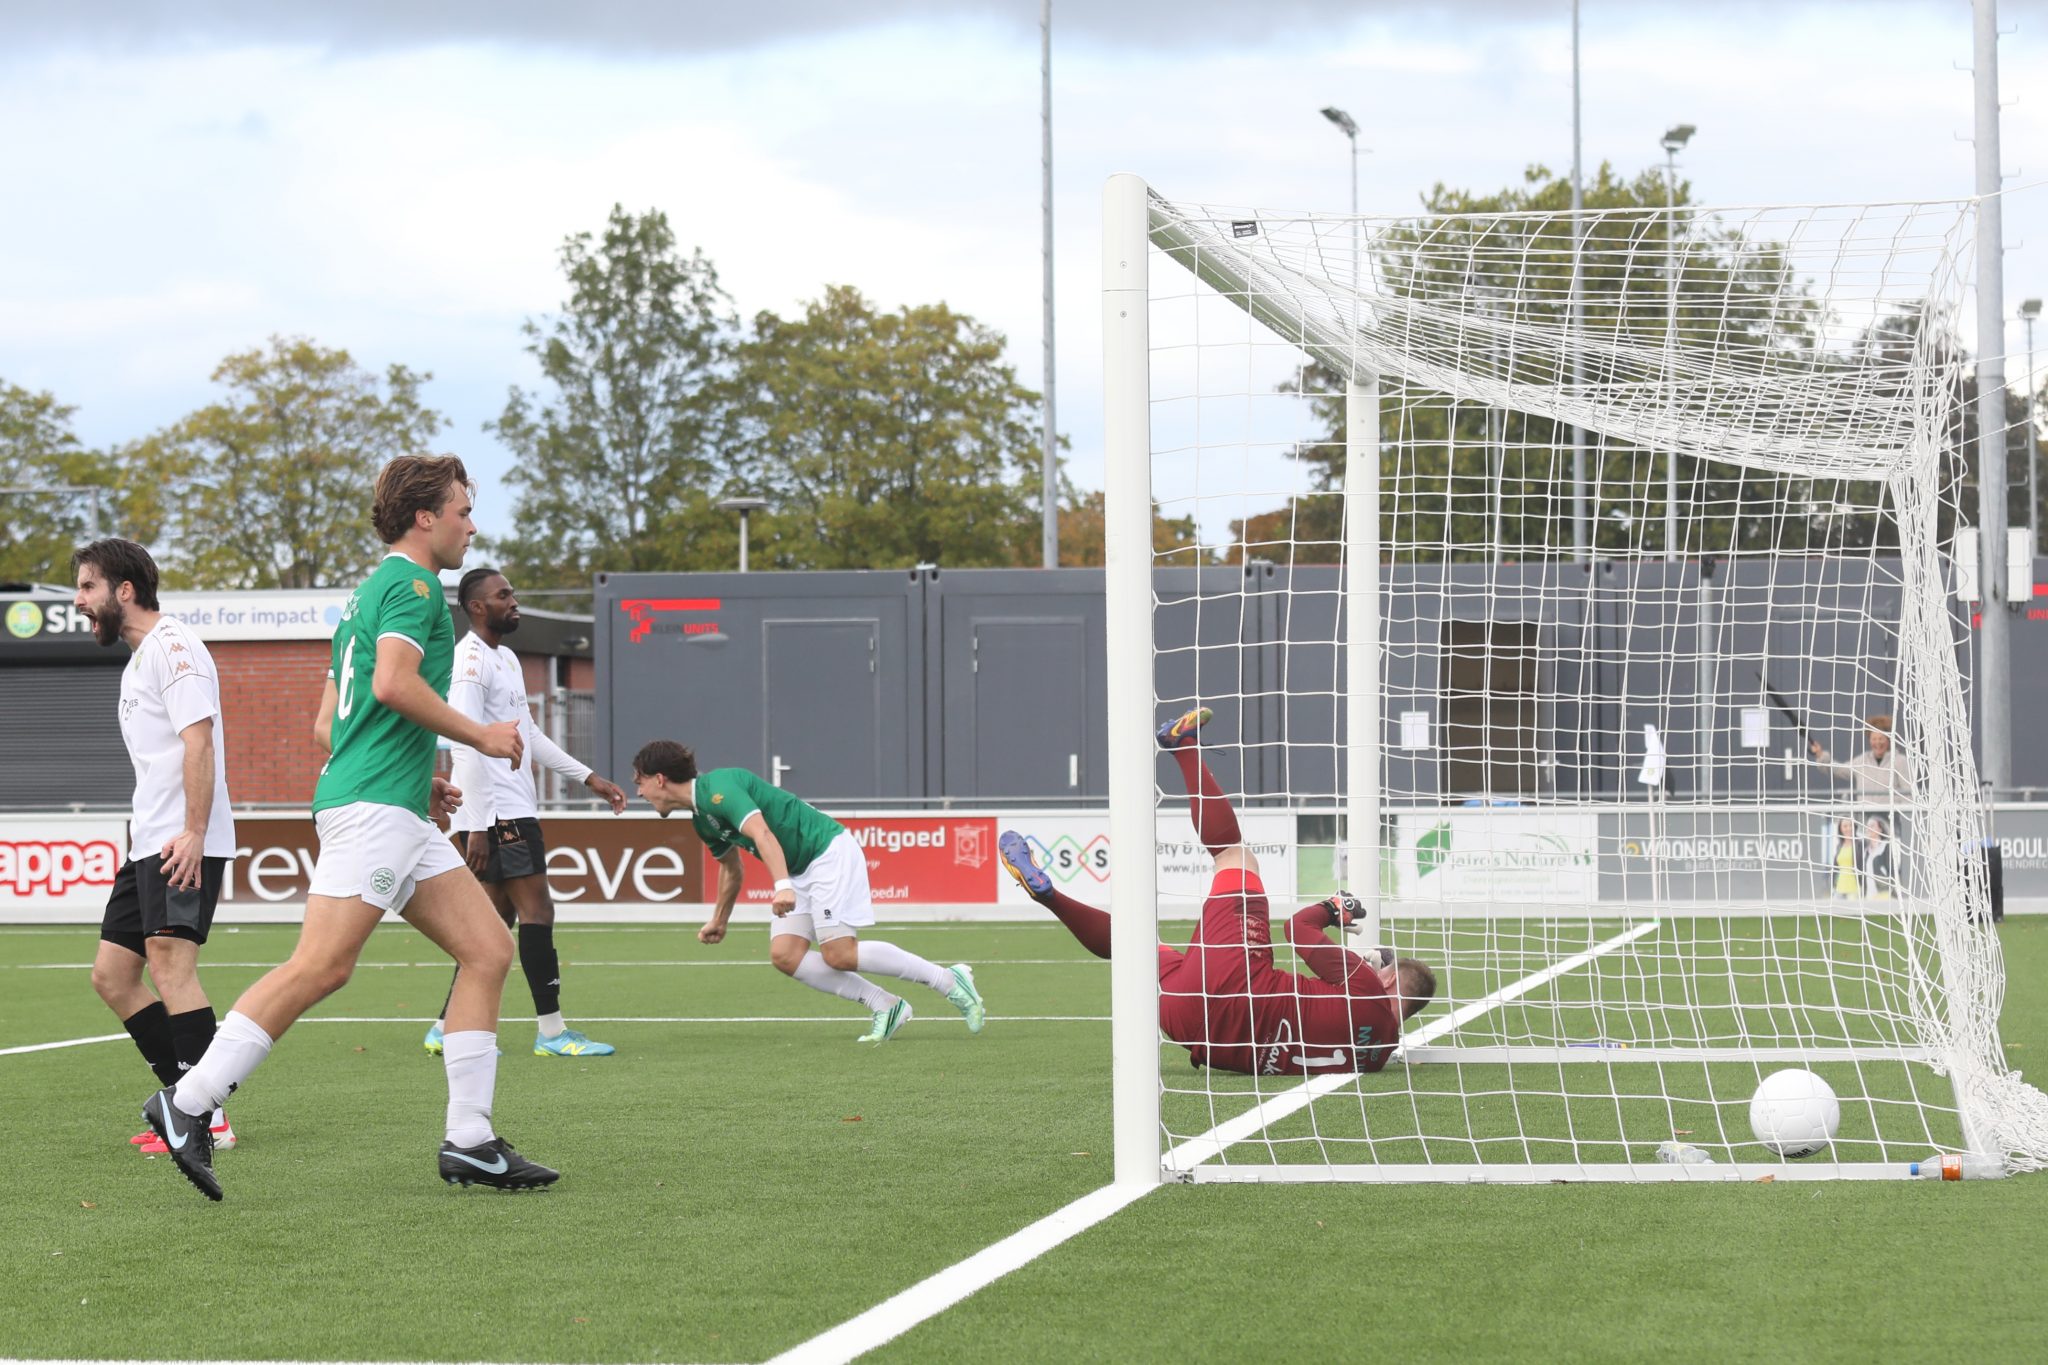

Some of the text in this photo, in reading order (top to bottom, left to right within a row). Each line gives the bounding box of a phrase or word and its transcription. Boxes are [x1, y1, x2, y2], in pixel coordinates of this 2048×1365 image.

[217, 607, 245, 624] for
[251, 606, 318, 627] impact
[852, 826, 945, 852] Witgoed
[1641, 838, 1804, 861] WOONBOULEVARD
[1291, 1048, 1347, 1068] 1
